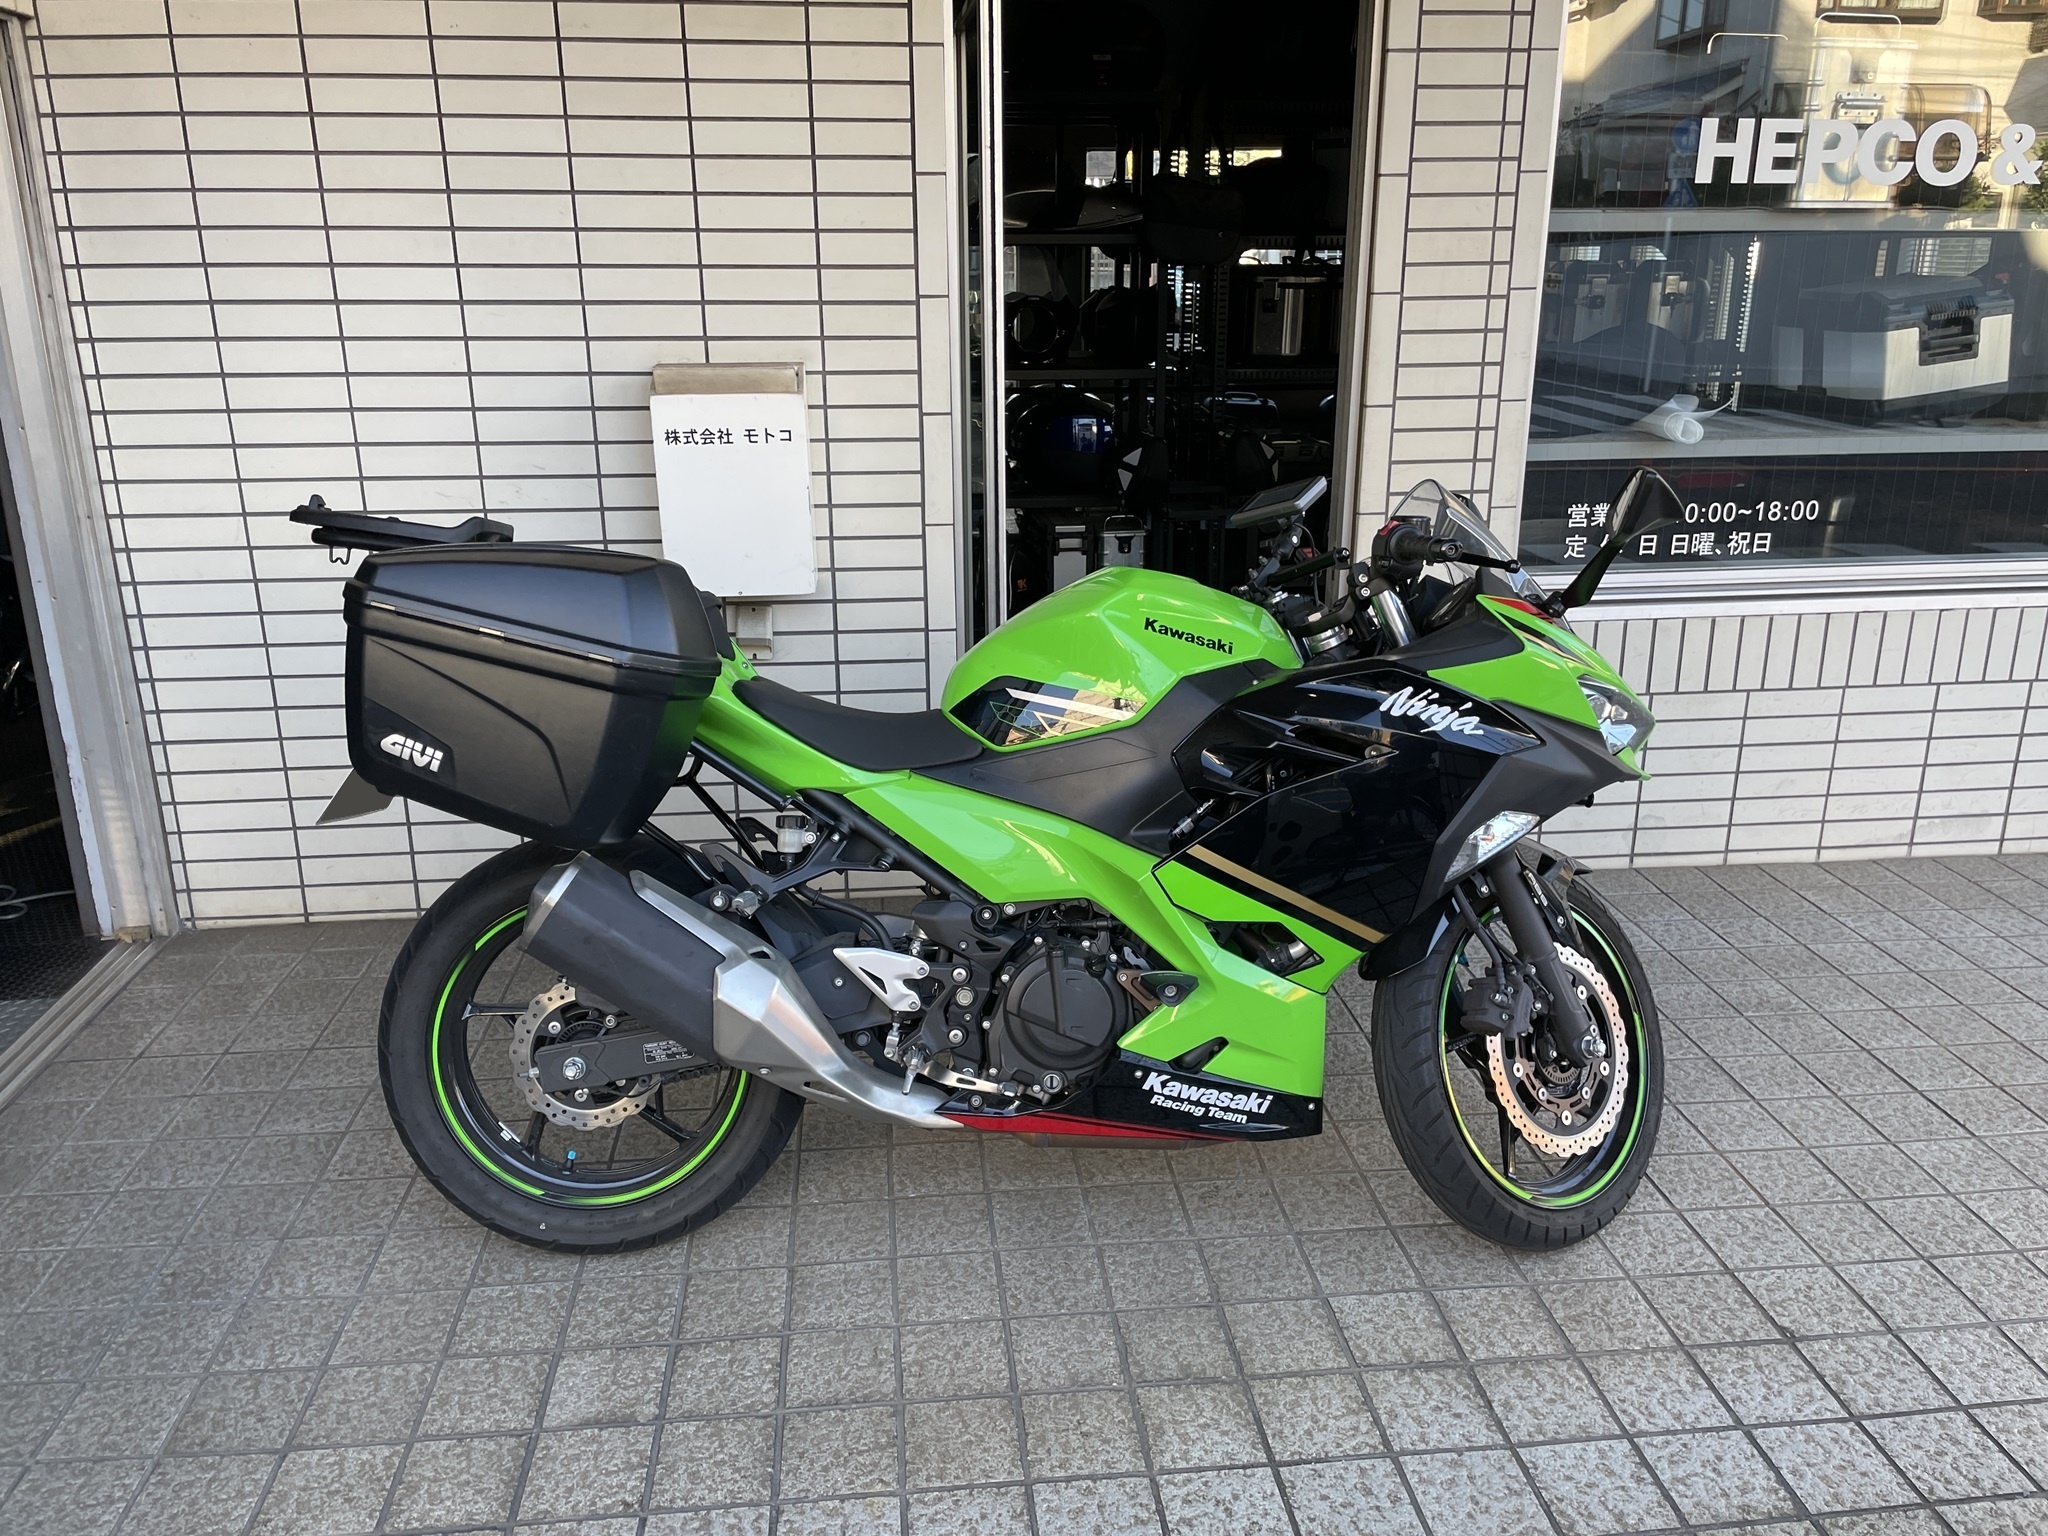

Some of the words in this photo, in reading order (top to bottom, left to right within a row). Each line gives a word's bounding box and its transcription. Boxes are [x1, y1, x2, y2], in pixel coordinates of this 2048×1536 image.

[1694, 117, 1978, 186] HEPCO
[1992, 123, 2043, 186] &
[664, 428, 734, 446] 株式会社
[743, 428, 792, 444] モトコ
[1676, 499, 1819, 524] 0:00~18:00
[1670, 531, 1772, 556] 日曜、祝日
[1143, 617, 1234, 655] Kawasaki
[1379, 685, 1484, 735] Ninja
[381, 734, 444, 772] GIVI
[1142, 1072, 1273, 1114] Kawasaki
[1150, 1095, 1206, 1116] Racing
[1207, 1106, 1248, 1124] Team
